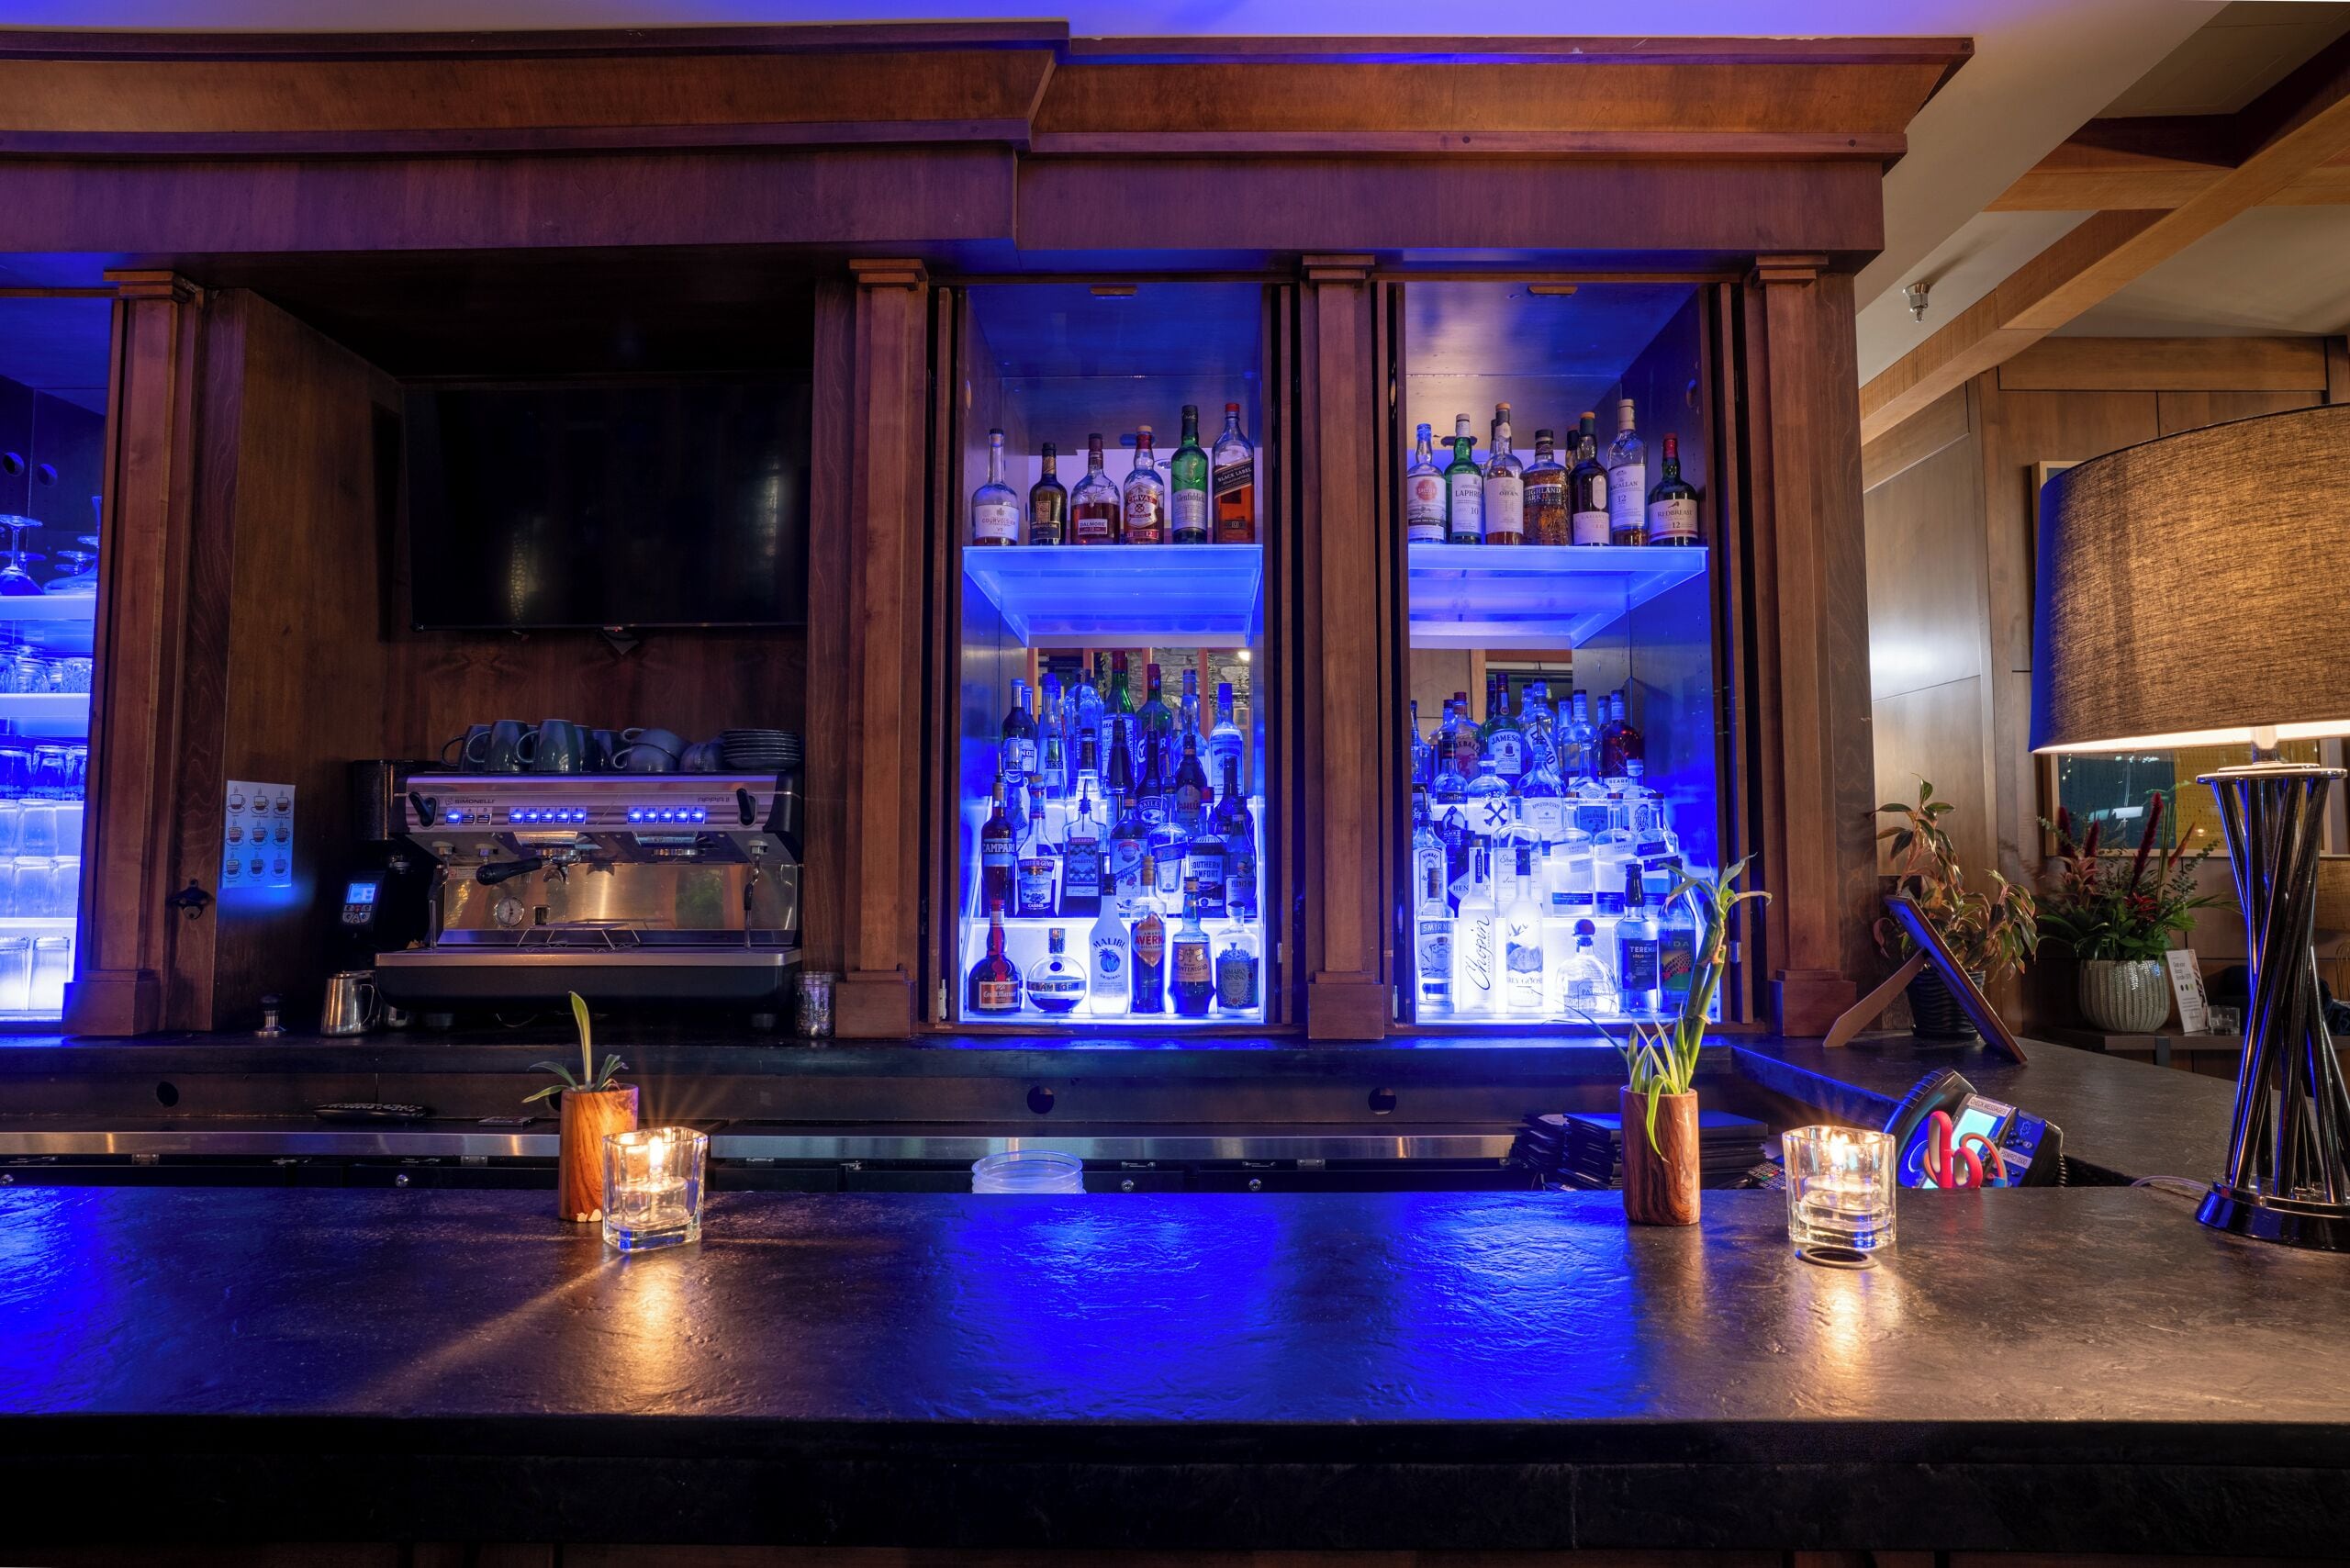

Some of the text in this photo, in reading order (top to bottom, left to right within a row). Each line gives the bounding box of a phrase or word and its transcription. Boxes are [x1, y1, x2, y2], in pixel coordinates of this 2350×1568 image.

[1217, 472, 1236, 482] BLACK
[1236, 466, 1252, 476] LABEL
[1617, 494, 1627, 502] 12
[1491, 734, 1520, 745] JAMESO
[1465, 915, 1494, 991] Chopin
[1970, 1098, 2008, 1115] CHECK MESSAGES
